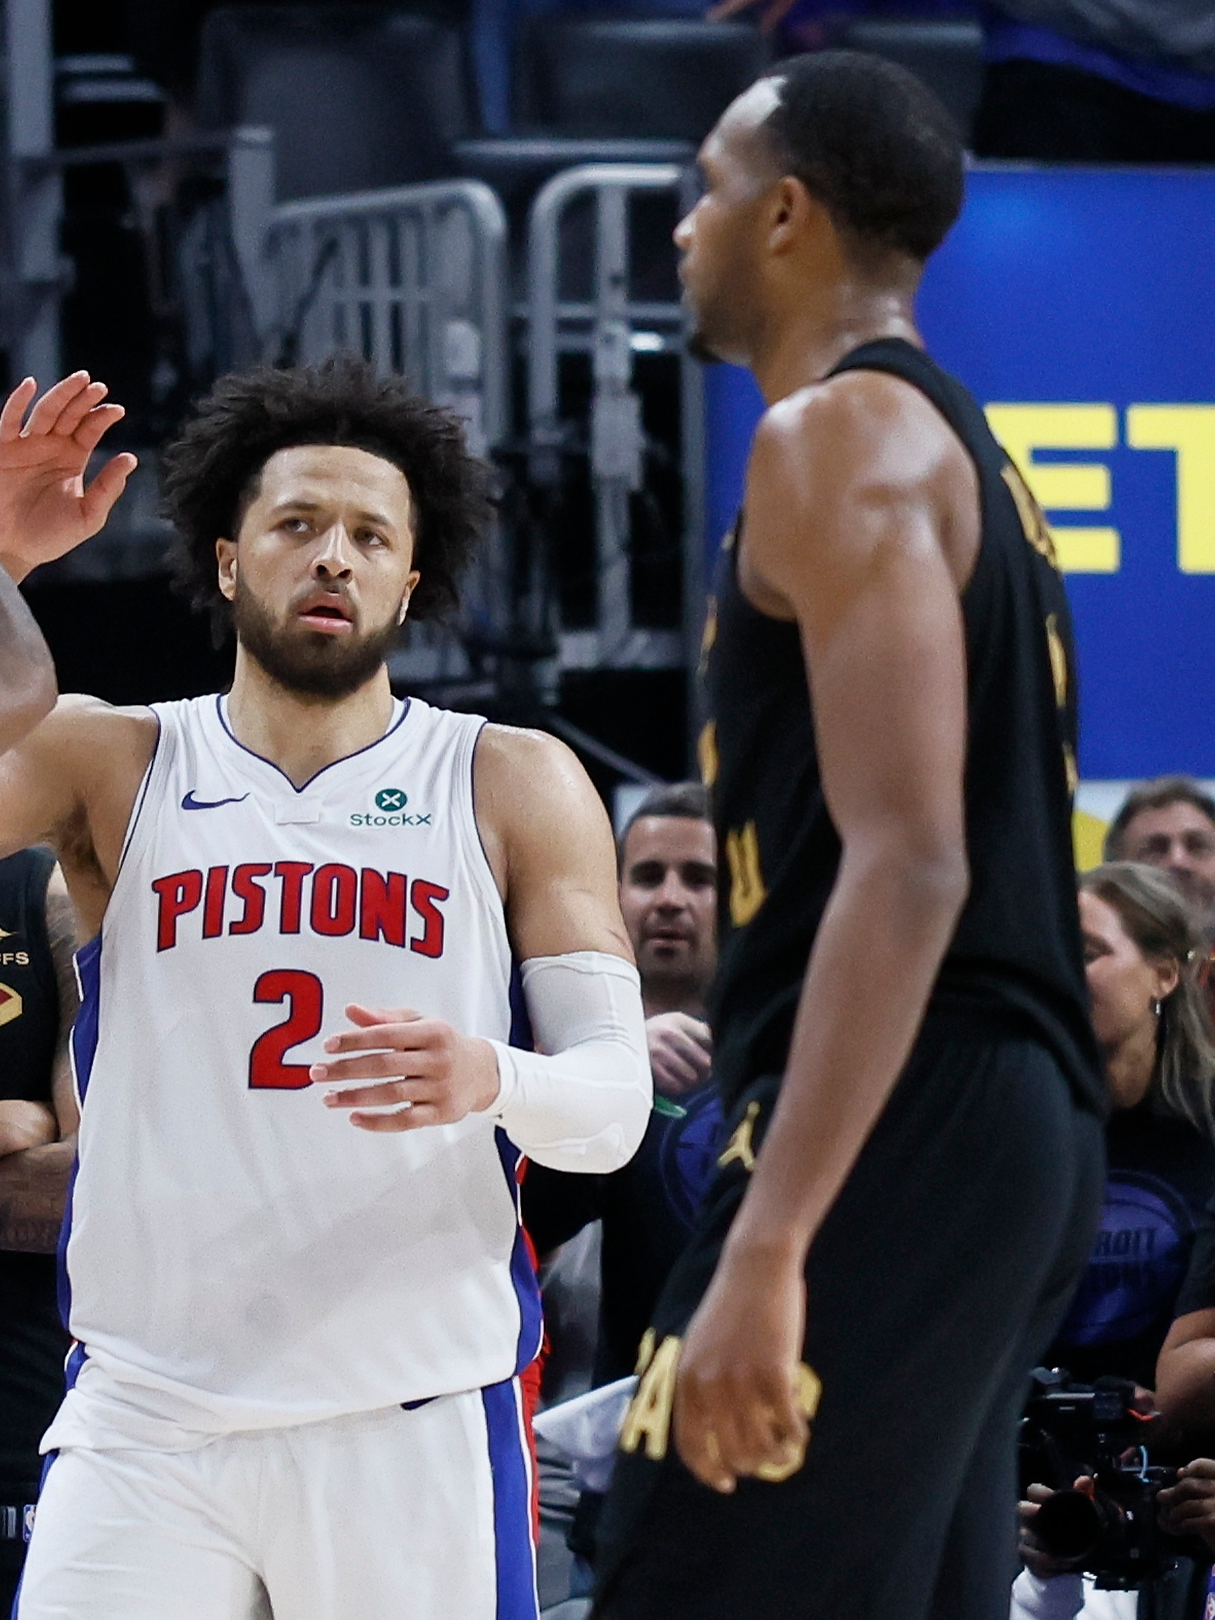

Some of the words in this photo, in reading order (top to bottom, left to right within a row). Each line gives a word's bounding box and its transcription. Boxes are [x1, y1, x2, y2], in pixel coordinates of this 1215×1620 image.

[350, 813, 432, 826] StockX
[152, 861, 449, 958] PISTONS
[248, 968, 324, 1090] 2
